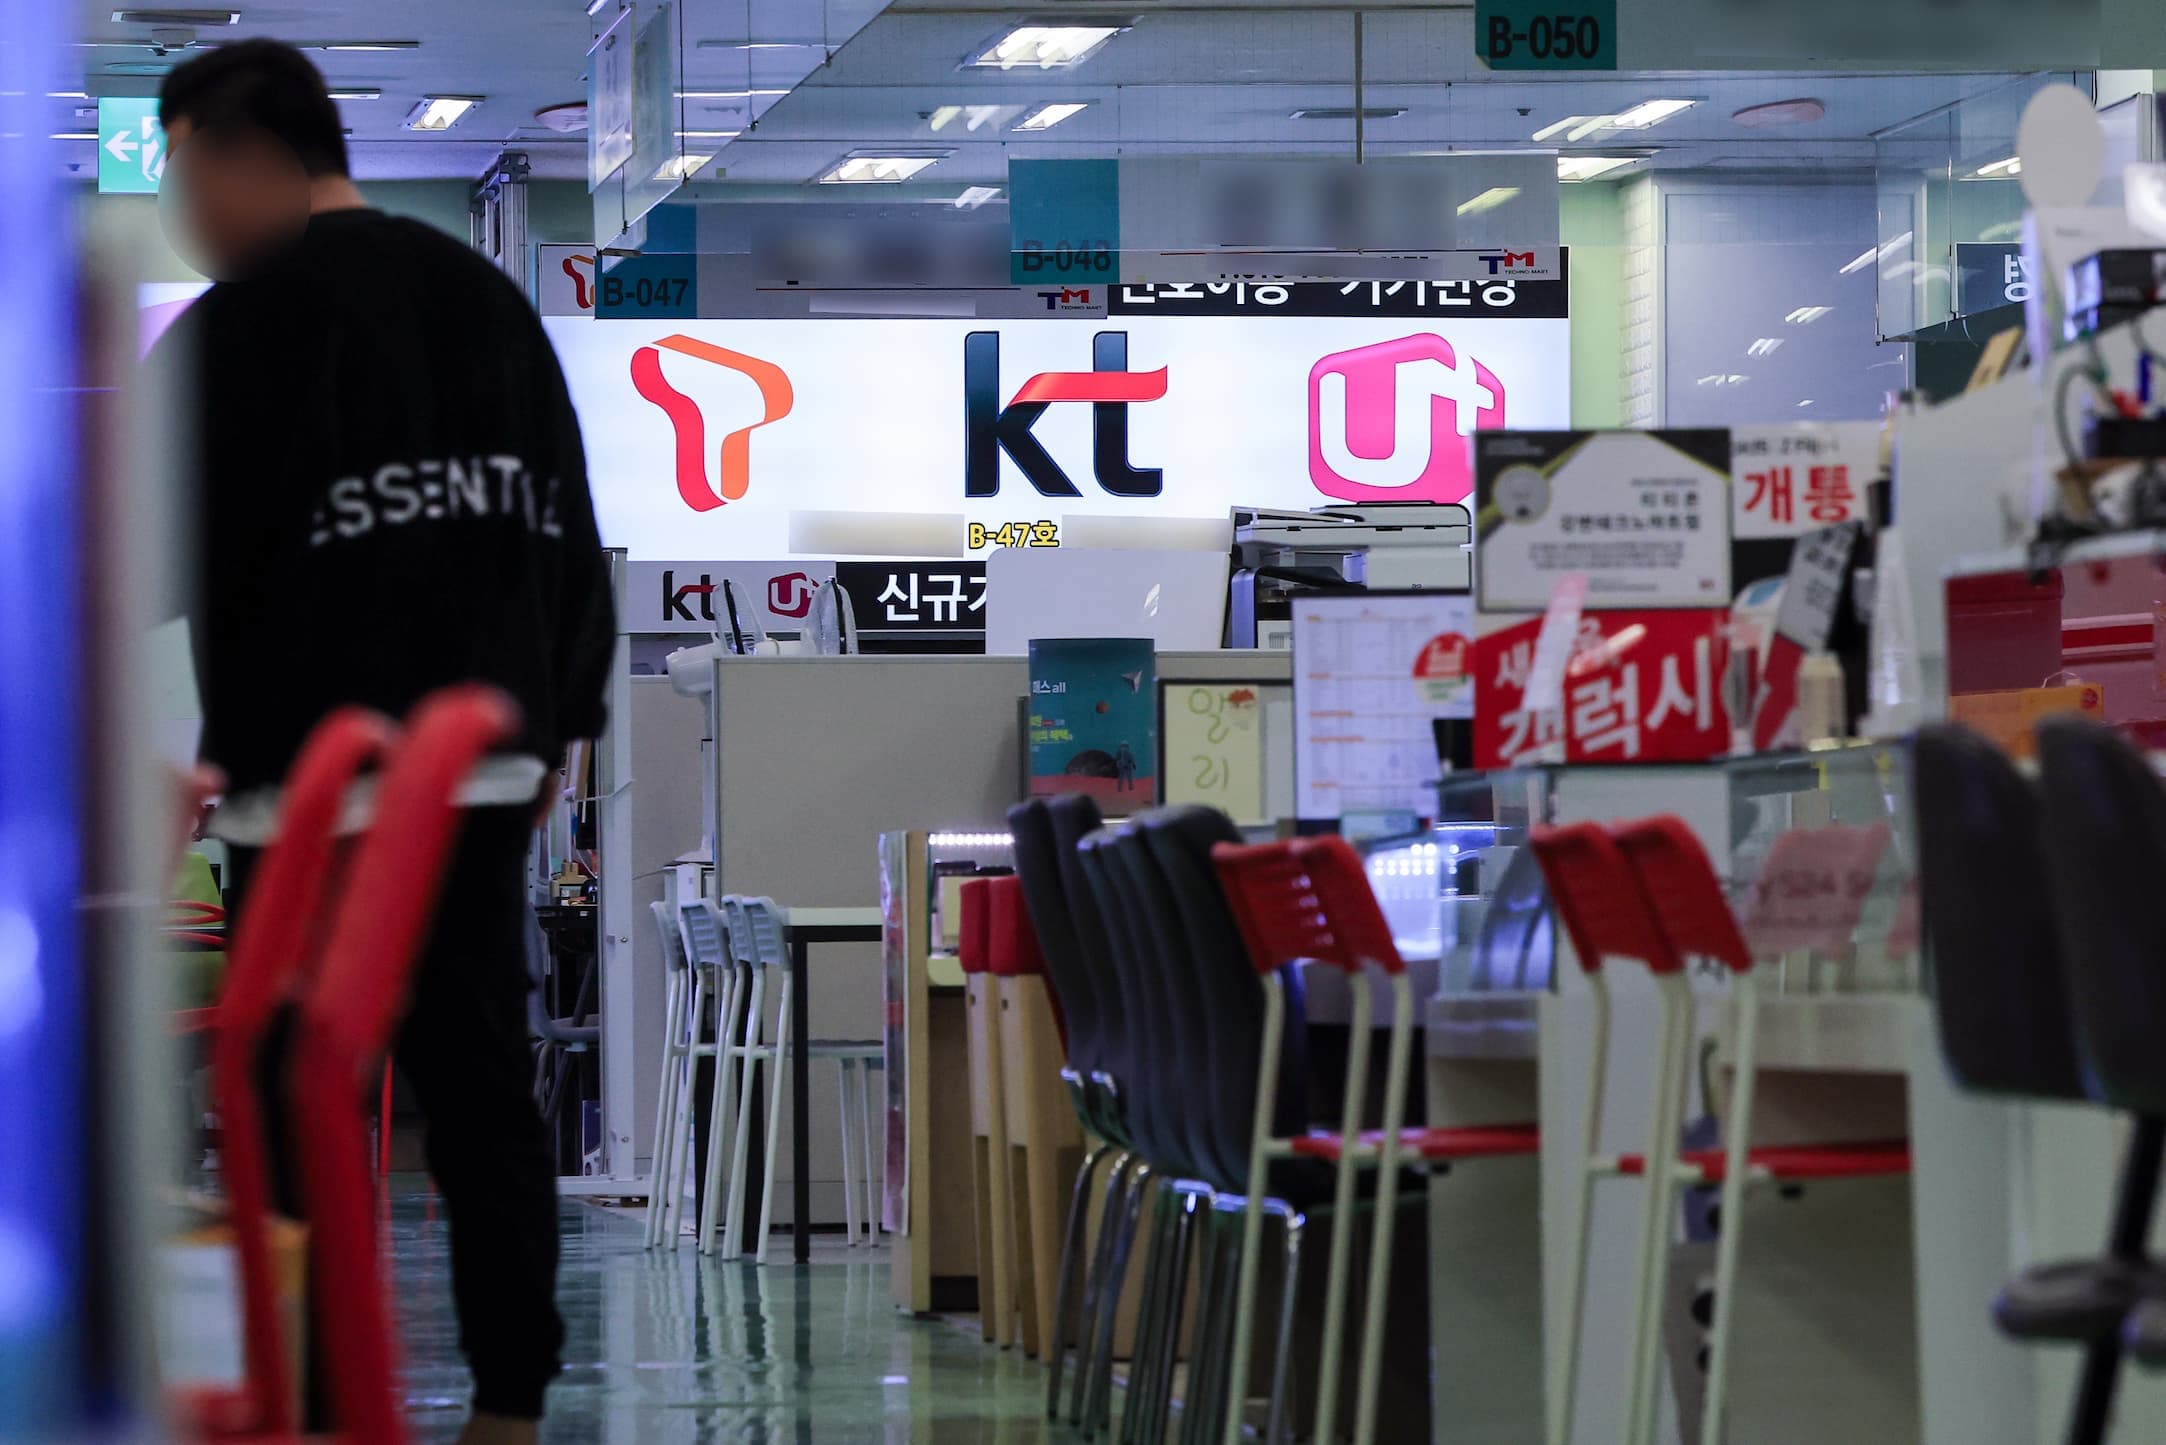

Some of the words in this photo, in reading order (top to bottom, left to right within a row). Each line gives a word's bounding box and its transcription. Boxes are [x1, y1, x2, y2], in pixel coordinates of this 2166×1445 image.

[1489, 15, 1600, 60] B-050
[1023, 239, 1111, 271] B-048
[603, 277, 688, 307] B-047
[964, 331, 1168, 498] kt
[1743, 464, 1856, 524] 개통
[968, 520, 1060, 549] B-47호
[662, 570, 718, 621] kt
